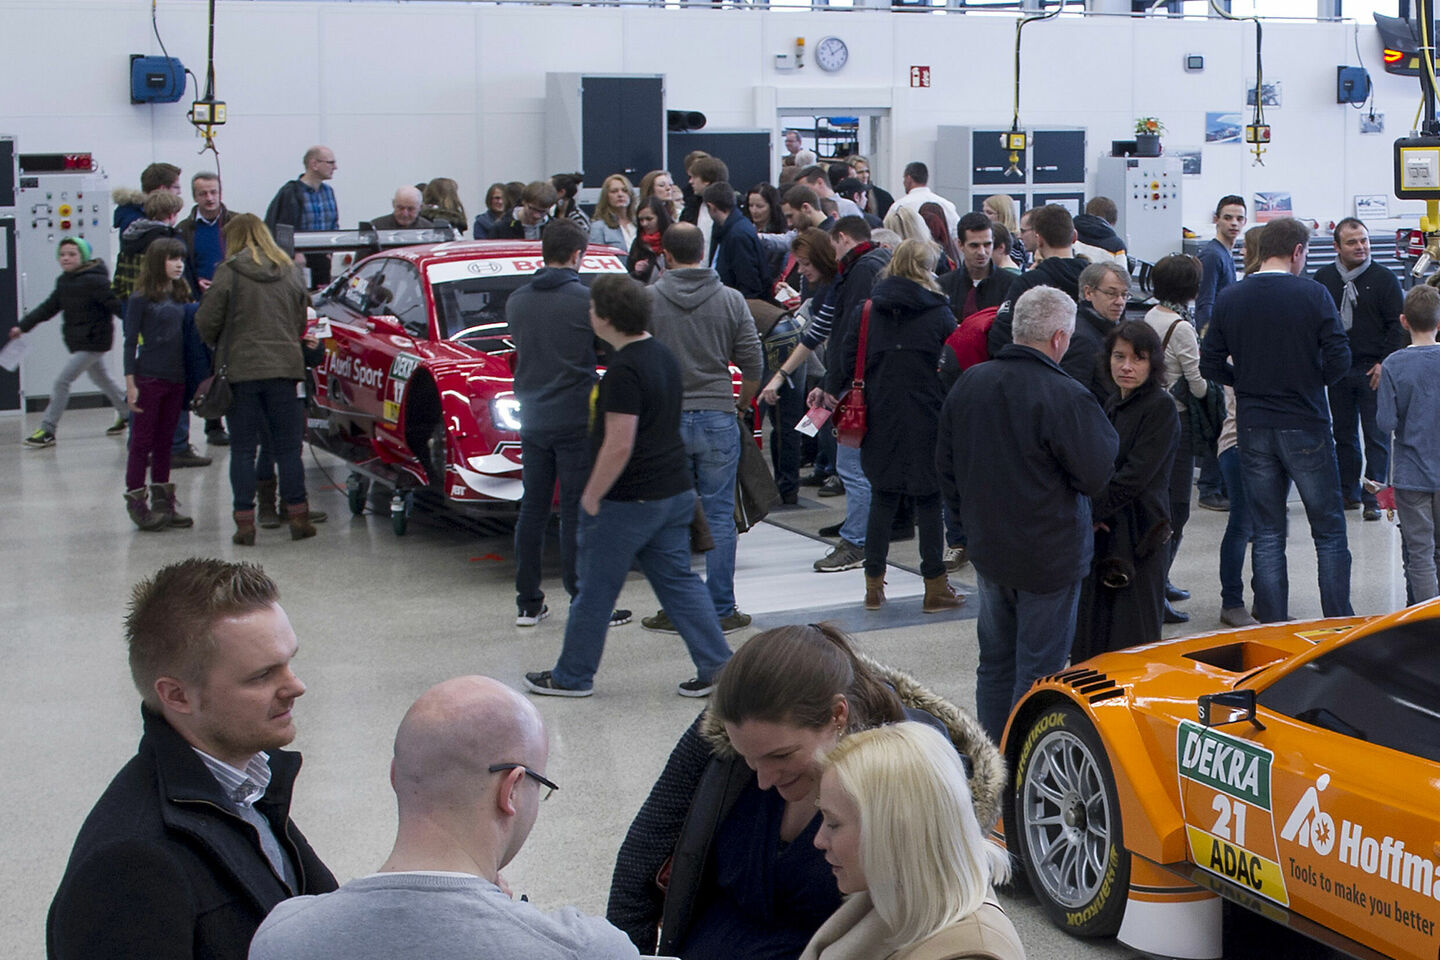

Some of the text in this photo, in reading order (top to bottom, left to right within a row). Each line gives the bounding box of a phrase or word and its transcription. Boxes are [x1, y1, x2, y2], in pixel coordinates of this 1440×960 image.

[329, 353, 384, 389] Audi Sport
[1181, 730, 1259, 797] DEKRA
[1211, 793, 1247, 847] 21
[1210, 839, 1263, 890] ADAC
[1288, 857, 1436, 937] Tools to make you better
